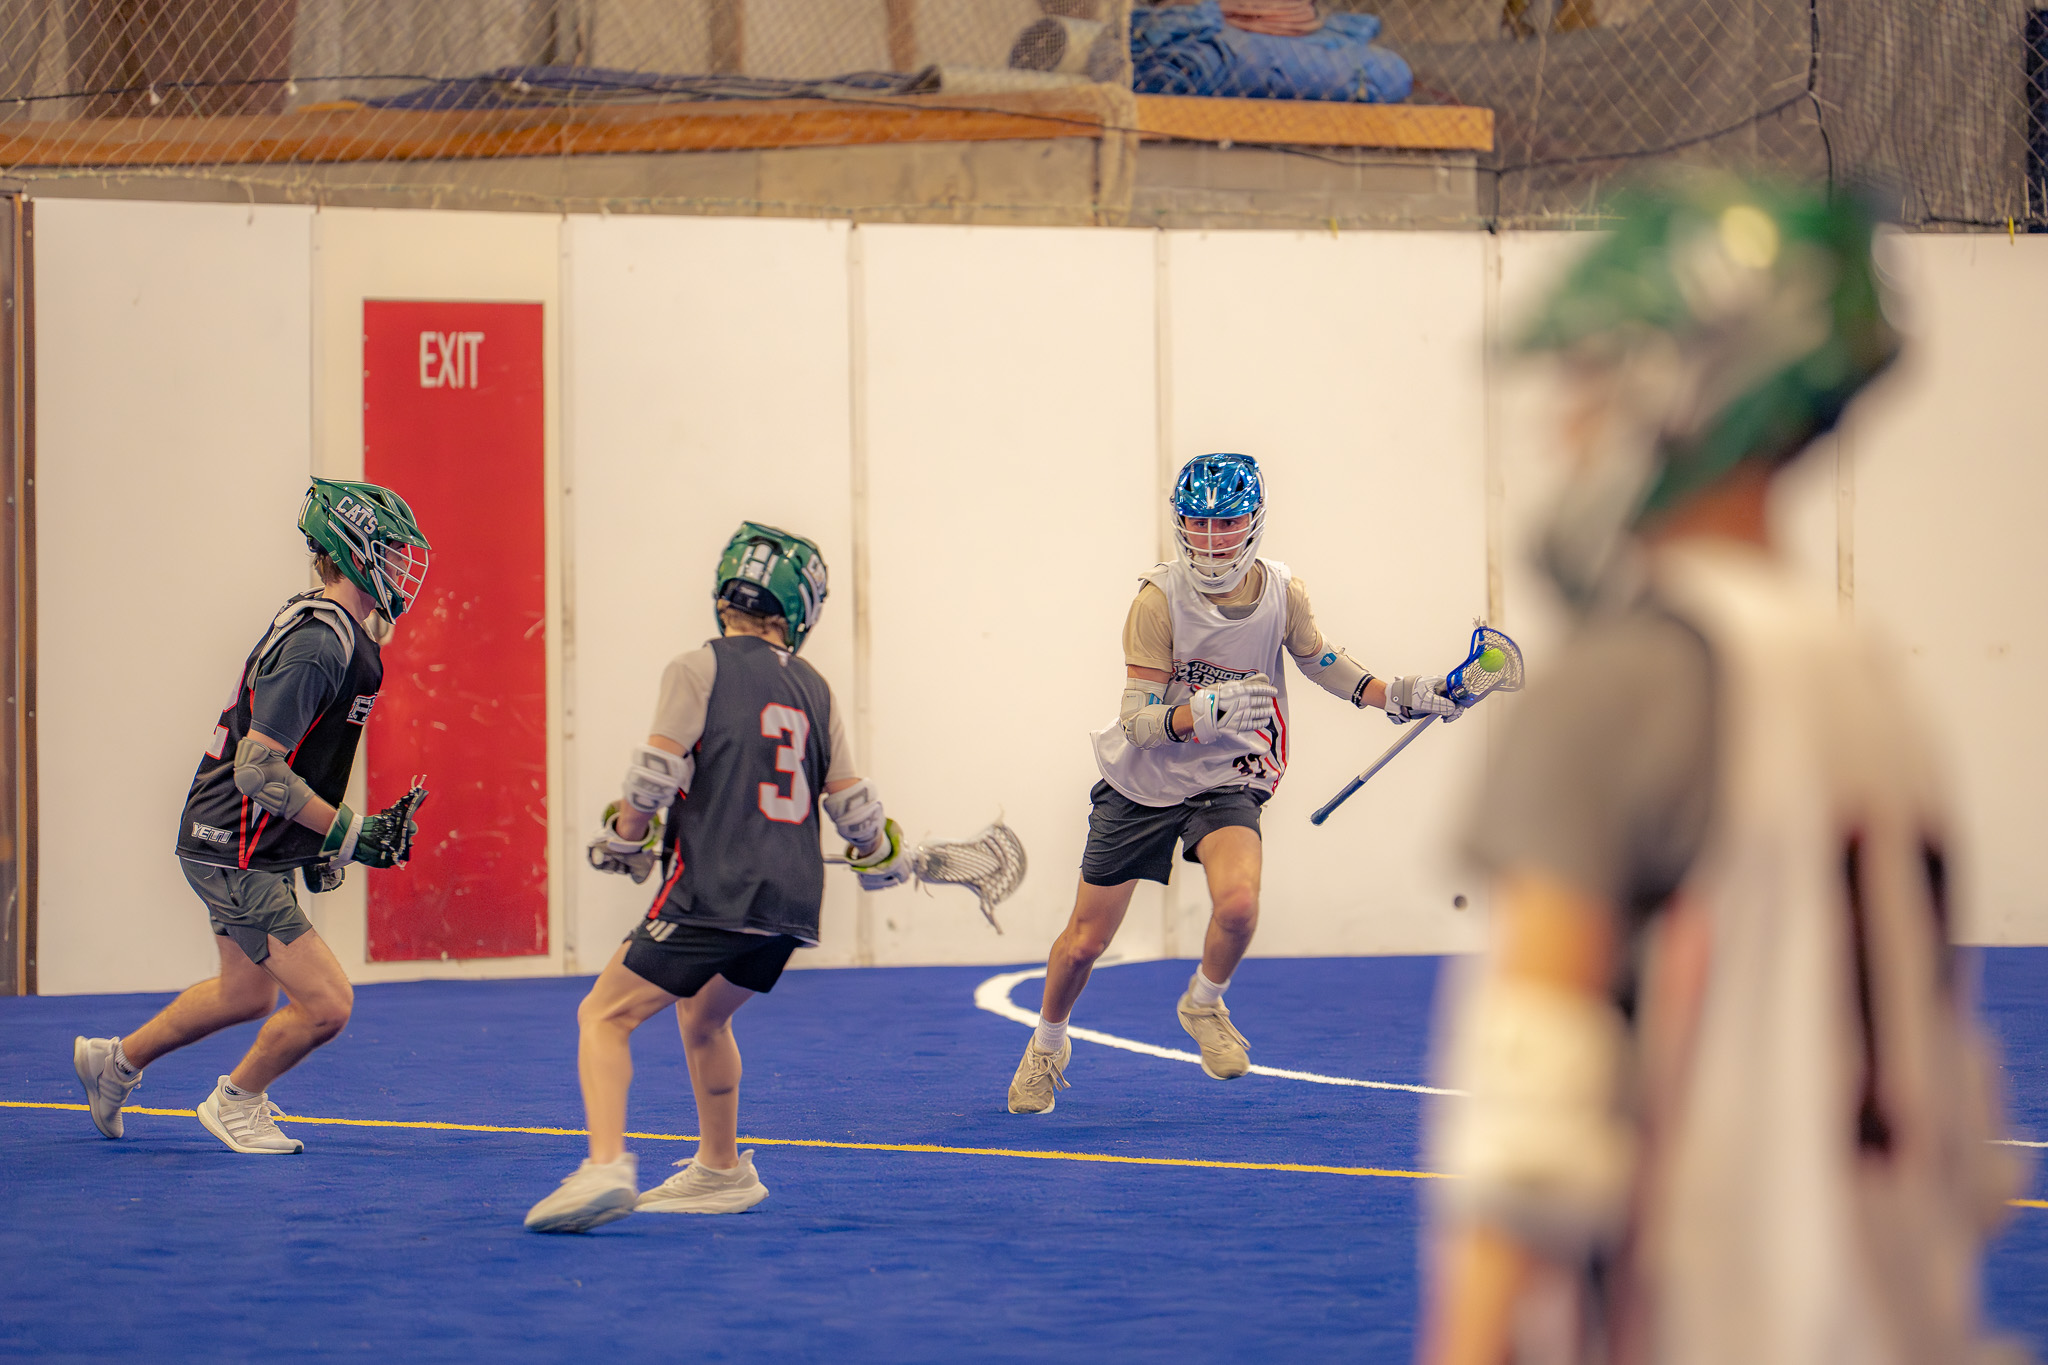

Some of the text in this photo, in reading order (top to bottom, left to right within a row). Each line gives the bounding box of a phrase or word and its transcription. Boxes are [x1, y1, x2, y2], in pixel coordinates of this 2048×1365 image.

[420, 331, 485, 389] EXIT
[335, 496, 379, 535] CATS
[758, 702, 811, 825] 3
[191, 821, 233, 844] YETI
